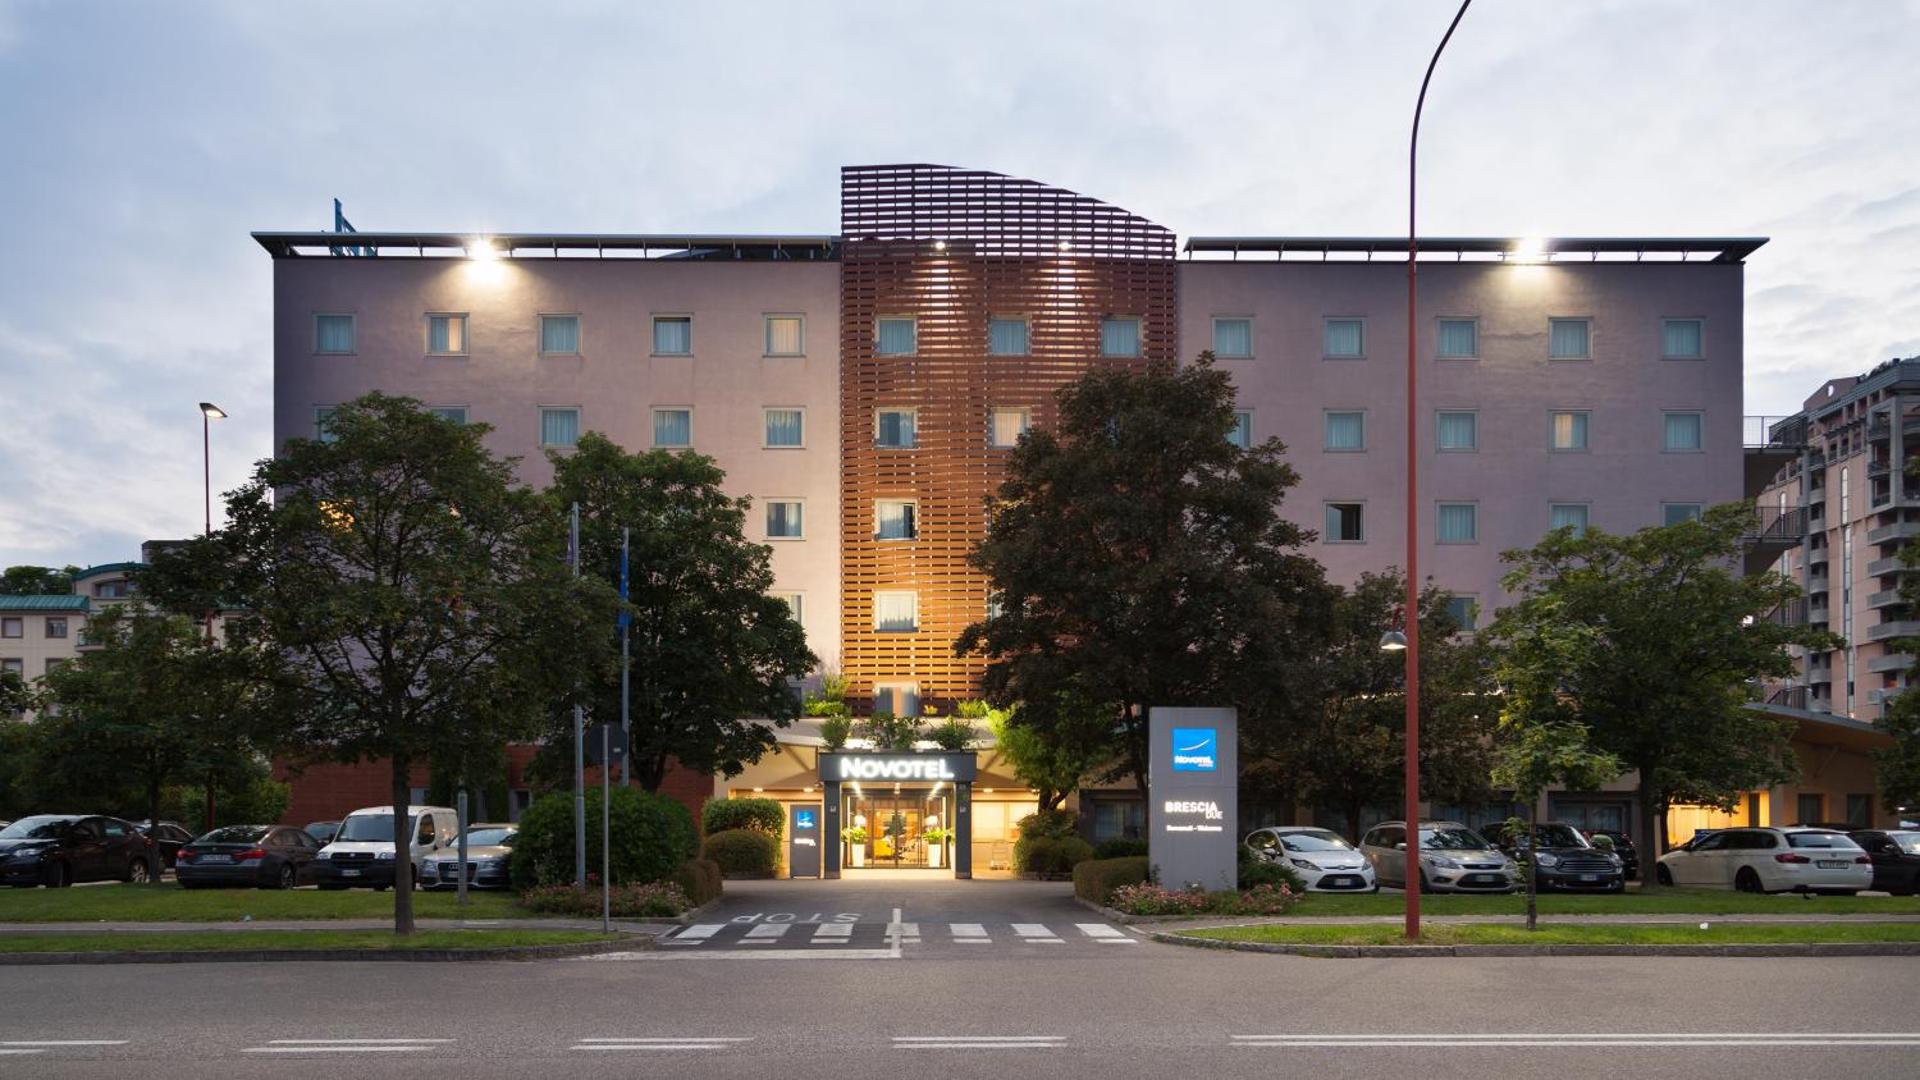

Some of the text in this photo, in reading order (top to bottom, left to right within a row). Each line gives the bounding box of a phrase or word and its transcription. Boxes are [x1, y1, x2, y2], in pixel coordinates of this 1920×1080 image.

[840, 757, 955, 779] NOVOTEL
[1164, 801, 1218, 813] BRESCIA
[1205, 810, 1223, 819] DUE
[731, 912, 862, 923] STOP
